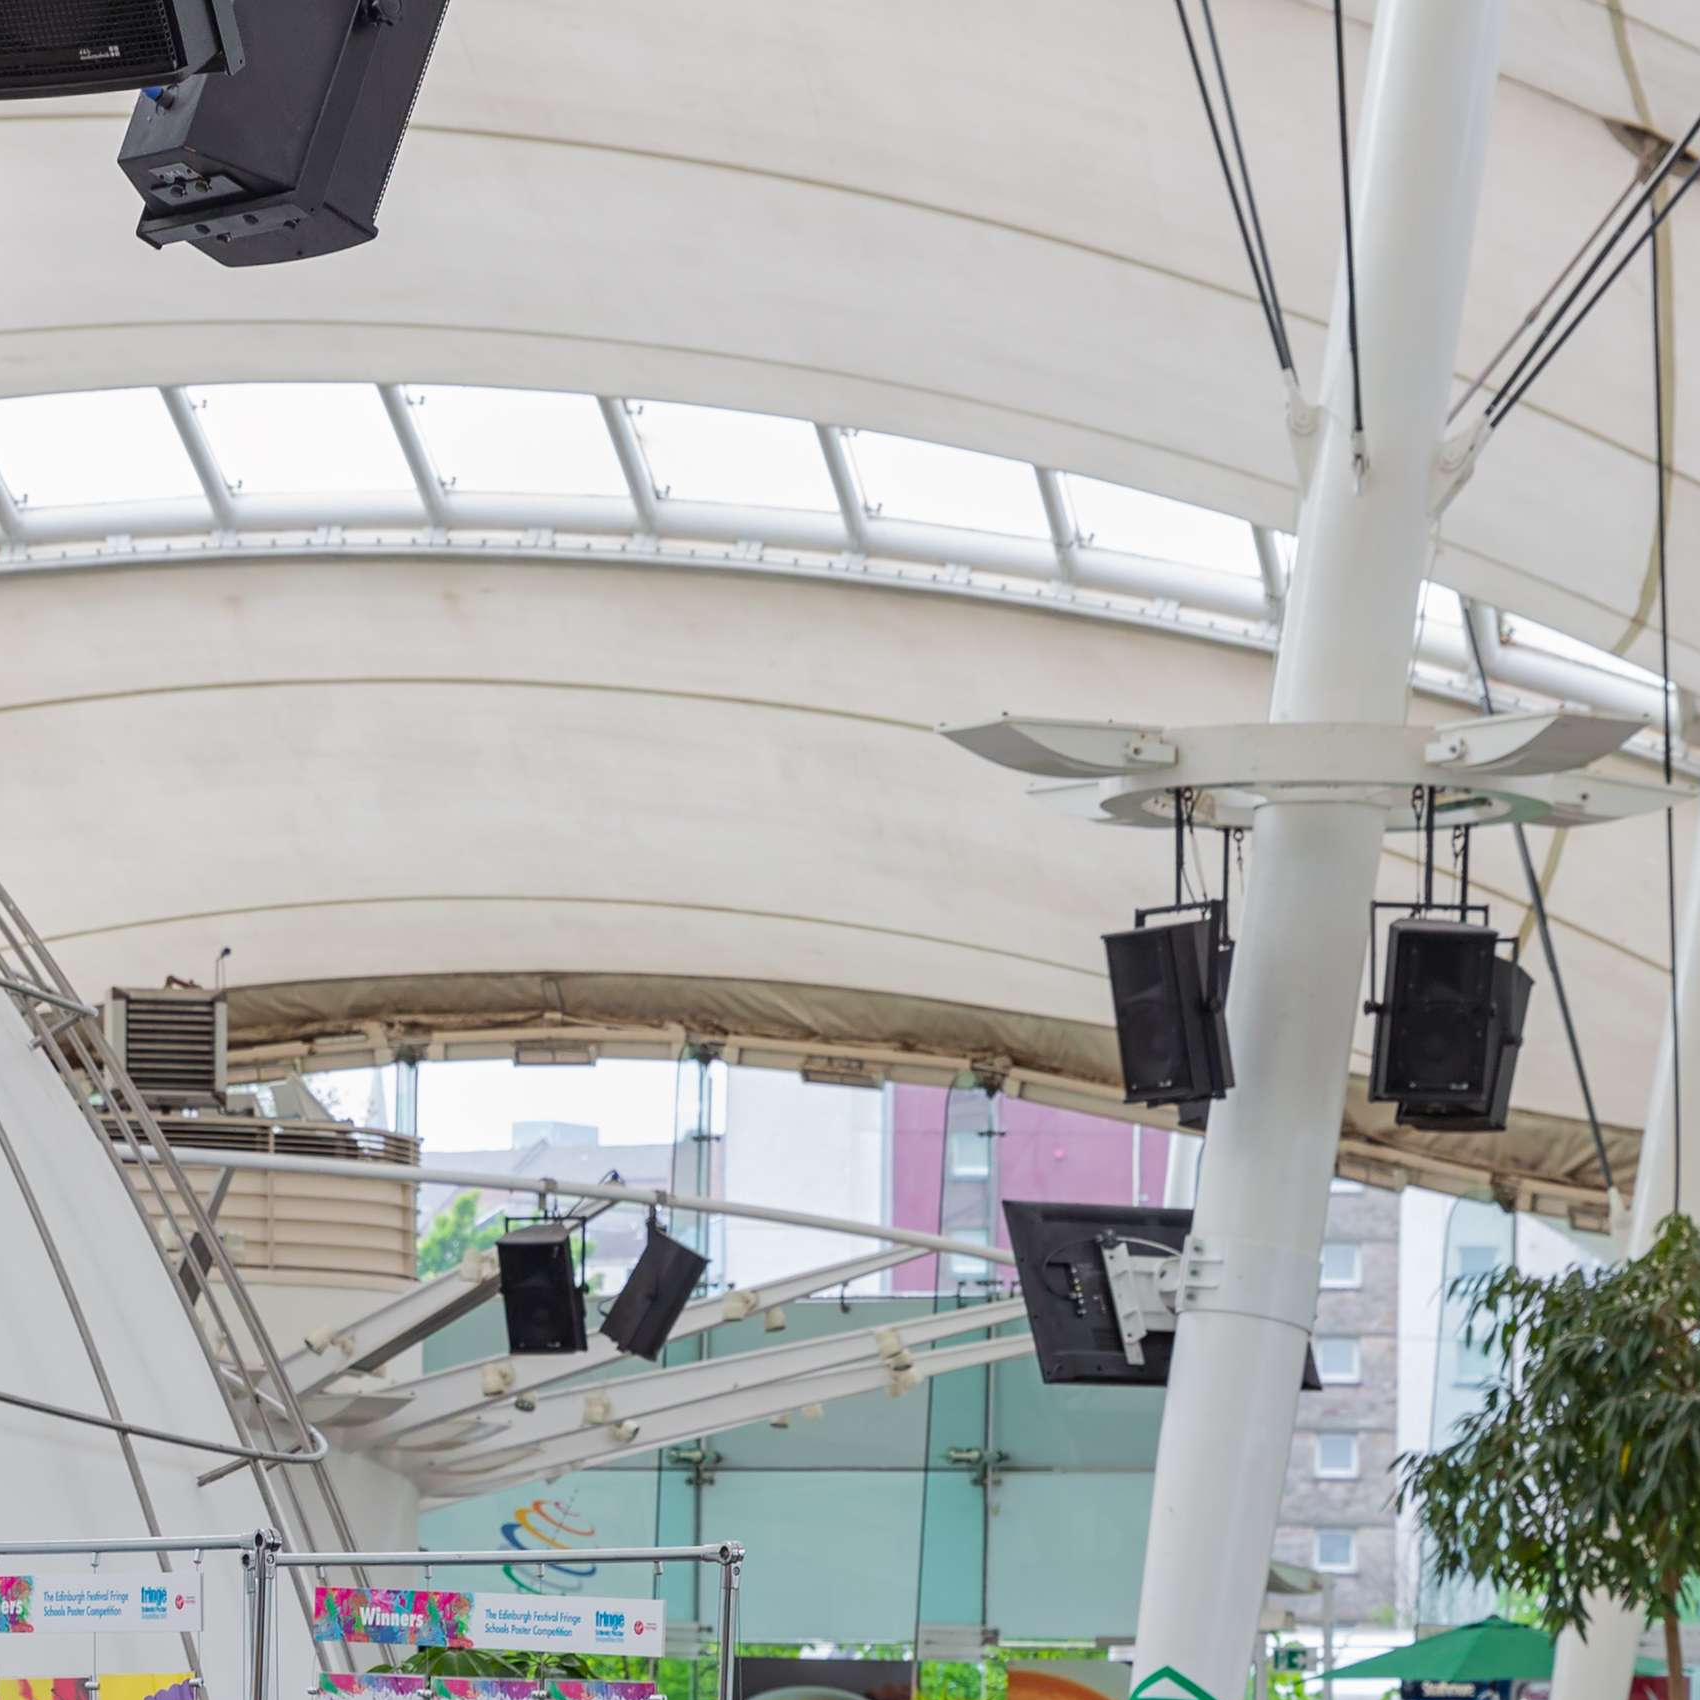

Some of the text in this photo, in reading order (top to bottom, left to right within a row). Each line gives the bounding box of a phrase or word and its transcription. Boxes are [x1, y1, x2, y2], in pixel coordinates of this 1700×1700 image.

[109, 1591, 129, 1604] Fringe
[141, 1586, 167, 1606] fringe
[86, 1606, 122, 1619] Competition
[359, 1606, 424, 1627] Winners
[485, 1609, 581, 1626] The Edinburgh Festival Fringe
[595, 1611, 625, 1630] fringe
[485, 1623, 573, 1638] Schools Poster Competition
